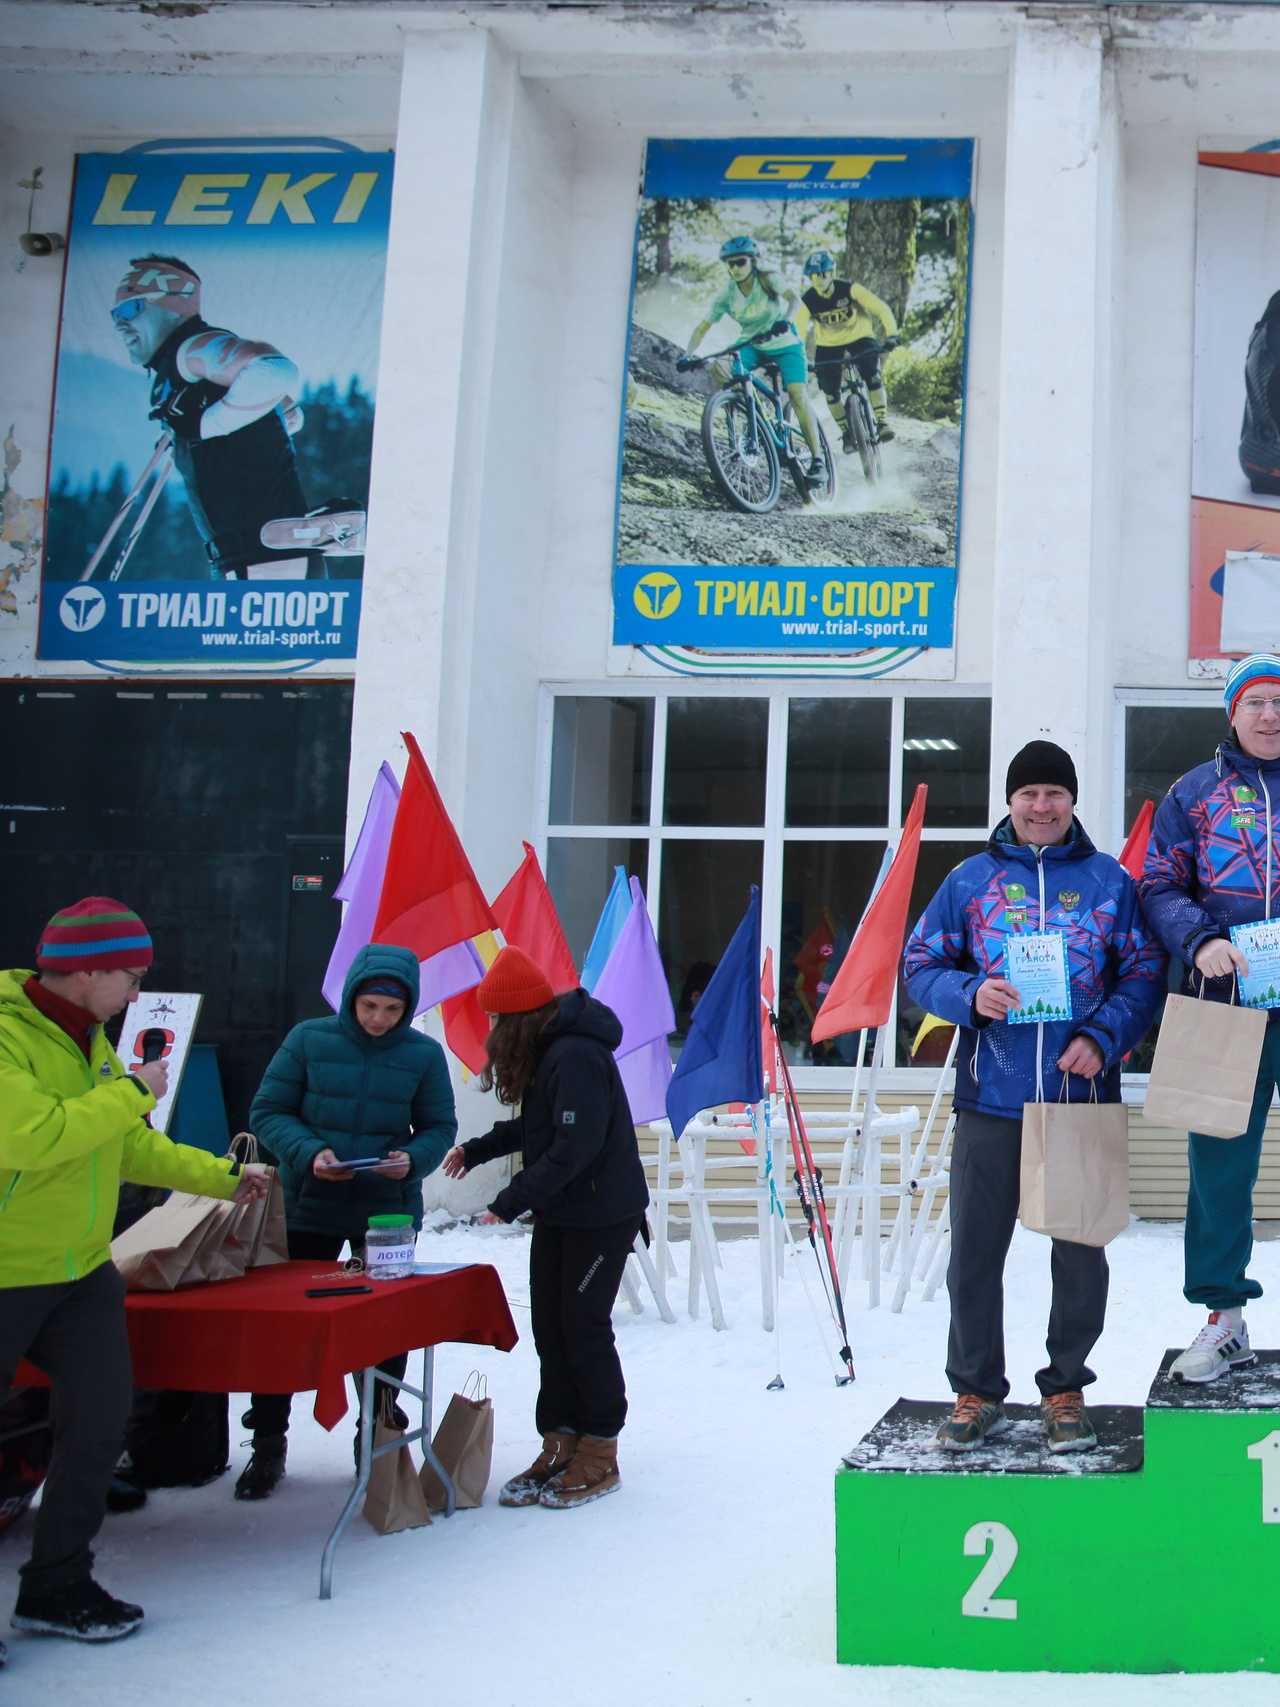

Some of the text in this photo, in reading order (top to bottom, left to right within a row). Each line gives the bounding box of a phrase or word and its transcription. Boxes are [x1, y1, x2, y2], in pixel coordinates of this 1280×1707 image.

[725, 154, 907, 180] GT
[786, 181, 861, 190] BICYCLES
[91, 172, 379, 226] LEKI
[202, 629, 341, 648] www.trial-sport.ru
[781, 620, 928, 639] www.trial-sport.ru
[1015, 954, 1057, 964] ГРАМОТА
[811, 1173, 823, 1204] NORDWAY
[377, 1249, 415, 1261] лотер
[578, 1254, 605, 1294] noname
[961, 1520, 1019, 1621] 2
